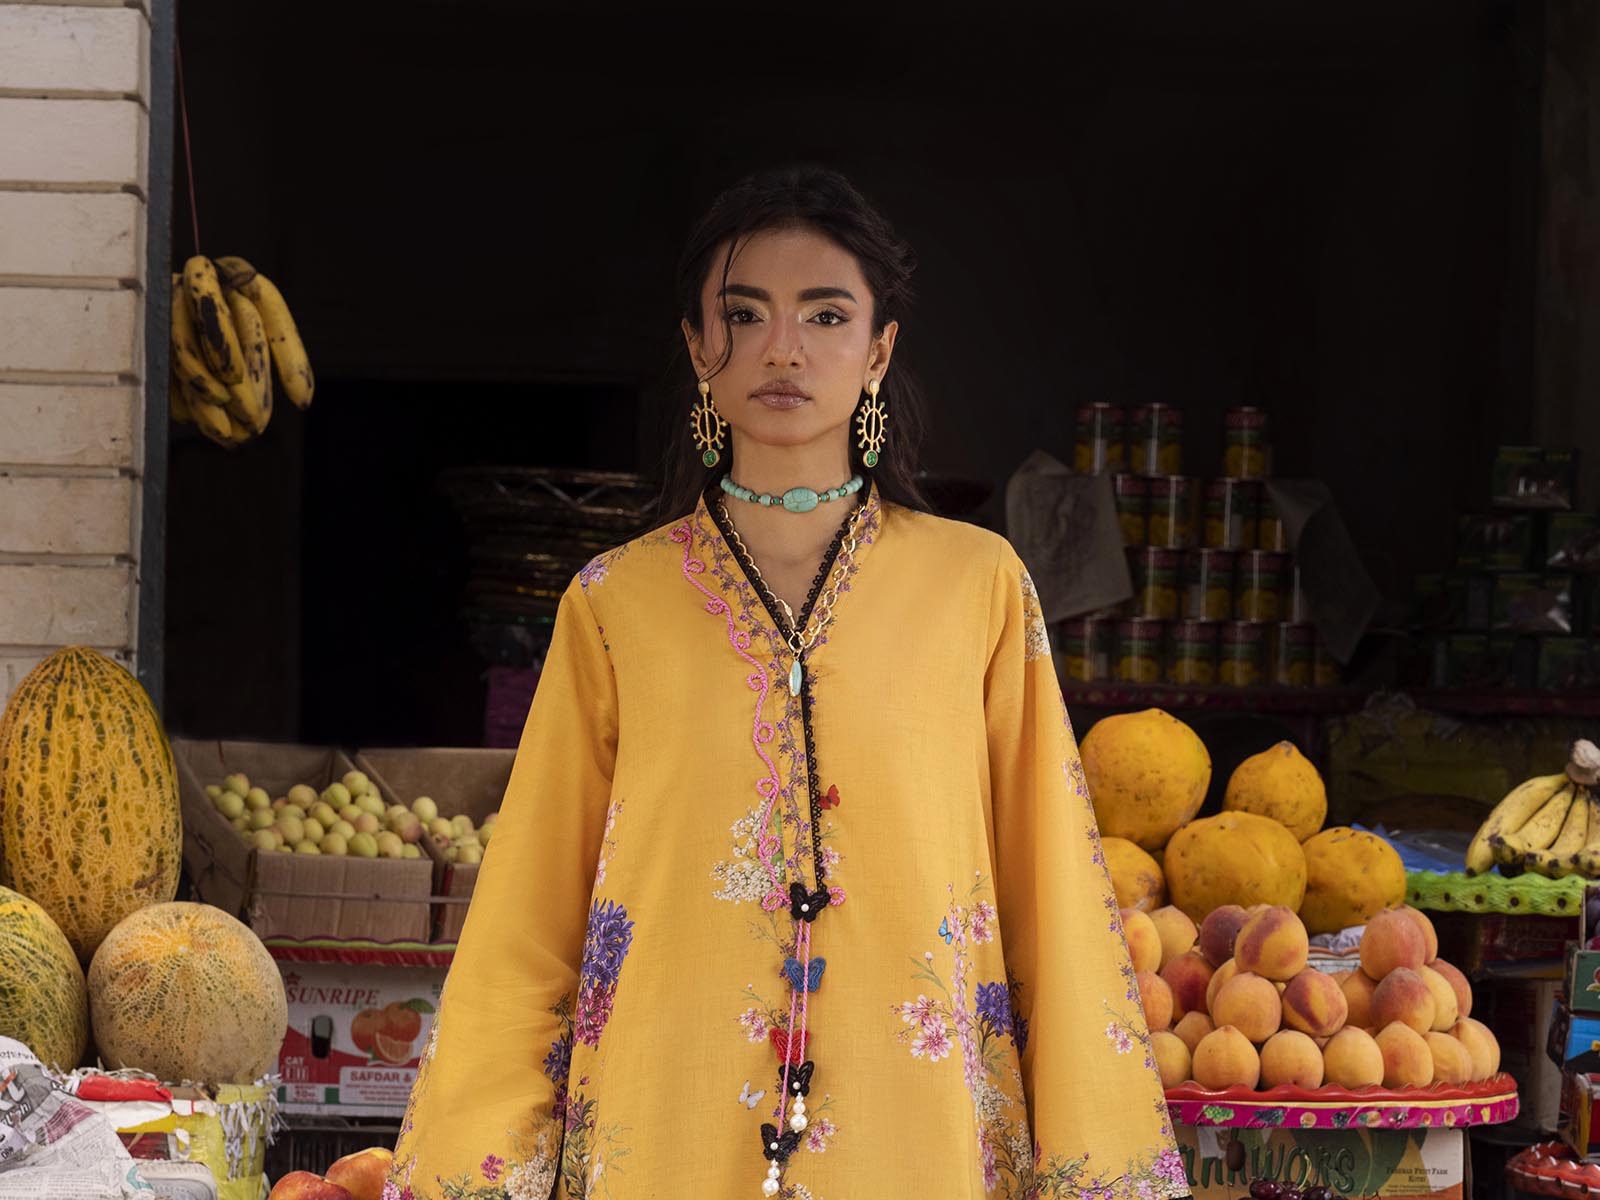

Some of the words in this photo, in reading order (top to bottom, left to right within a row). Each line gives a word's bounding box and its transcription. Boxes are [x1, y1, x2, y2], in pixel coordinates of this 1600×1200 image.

[287, 986, 380, 1007] SUNRIPE
[351, 1071, 400, 1083] SAFDAR
[404, 1071, 412, 1082] &
